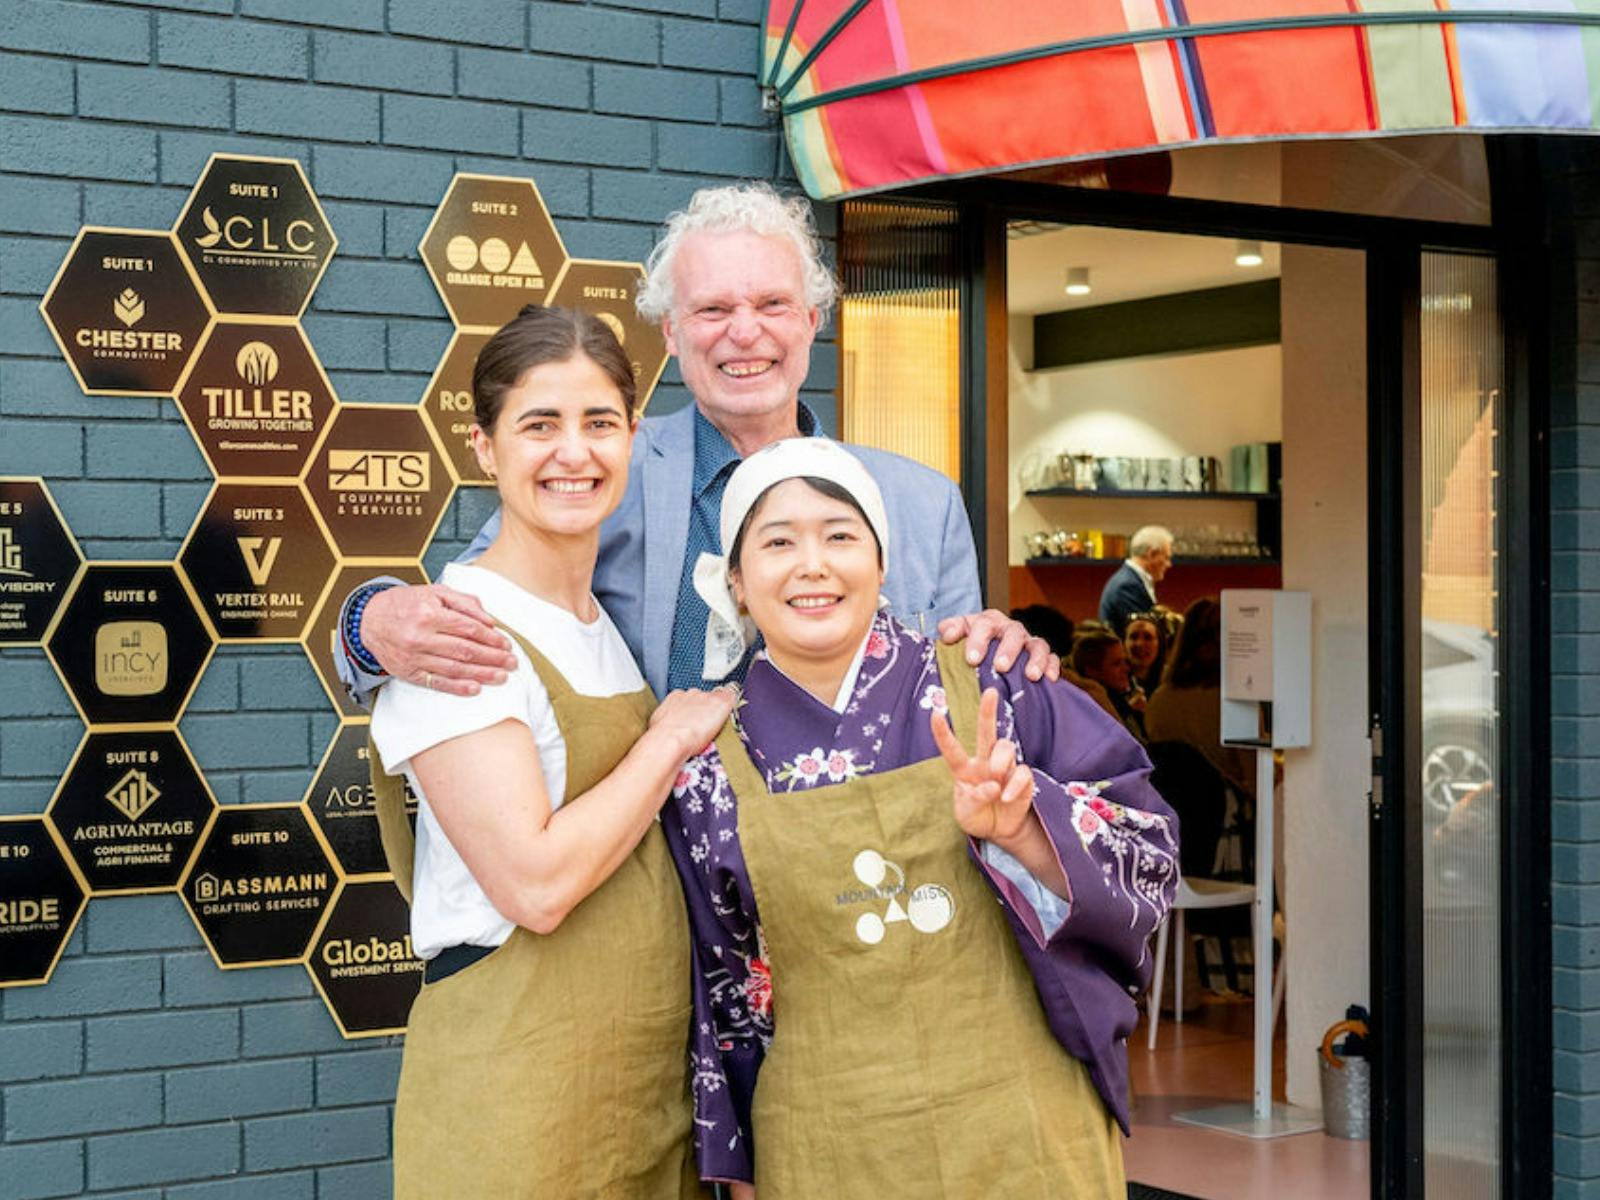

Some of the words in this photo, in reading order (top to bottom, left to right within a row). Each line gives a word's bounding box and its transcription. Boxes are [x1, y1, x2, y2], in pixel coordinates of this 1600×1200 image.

[229, 183, 270, 197] SUITE
[271, 186, 279, 199] 1
[471, 201, 509, 215] SUITE
[511, 204, 518, 216] 2
[223, 216, 315, 252] CLC
[102, 257, 143, 270] SUITE
[146, 259, 153, 272] 1
[447, 272, 491, 286] ORANGE
[493, 275, 523, 288] OPEN
[525, 277, 545, 289] AIR
[583, 286, 618, 299] SUITE
[620, 289, 627, 300] 2
[76, 328, 182, 351] CHESTER
[201, 388, 313, 419] TILLER
[208, 419, 259, 430] GROWING
[260, 420, 314, 432] TOGETHER
[335, 454, 424, 488] ATS
[338, 493, 421, 504] EQUIPMENT
[233, 508, 273, 520] SUITE
[275, 508, 284, 520] 3
[338, 505, 346, 515] &
[353, 506, 423, 516] SERVICES
[104, 590, 145, 602] SUITE
[148, 590, 157, 602] 6
[215, 593, 267, 606] VERTEX
[270, 593, 304, 606] RAIL
[106, 751, 147, 765] SUITE
[150, 751, 159, 763] 8
[74, 821, 194, 840] AGRIVANTAGE
[231, 832, 271, 846] SUITE
[273, 831, 289, 843] 10
[12, 845, 29, 858] 10
[93, 844, 163, 856] COMMERCIAL
[96, 855, 123, 866] AGRI
[125, 854, 171, 865] FINANCE
[199, 873, 327, 898] BASSMANN
[203, 901, 260, 915] DRAFTING
[265, 898, 319, 910] SERVICES
[322, 934, 412, 966] Global
[331, 963, 391, 977] INVESTMENT
